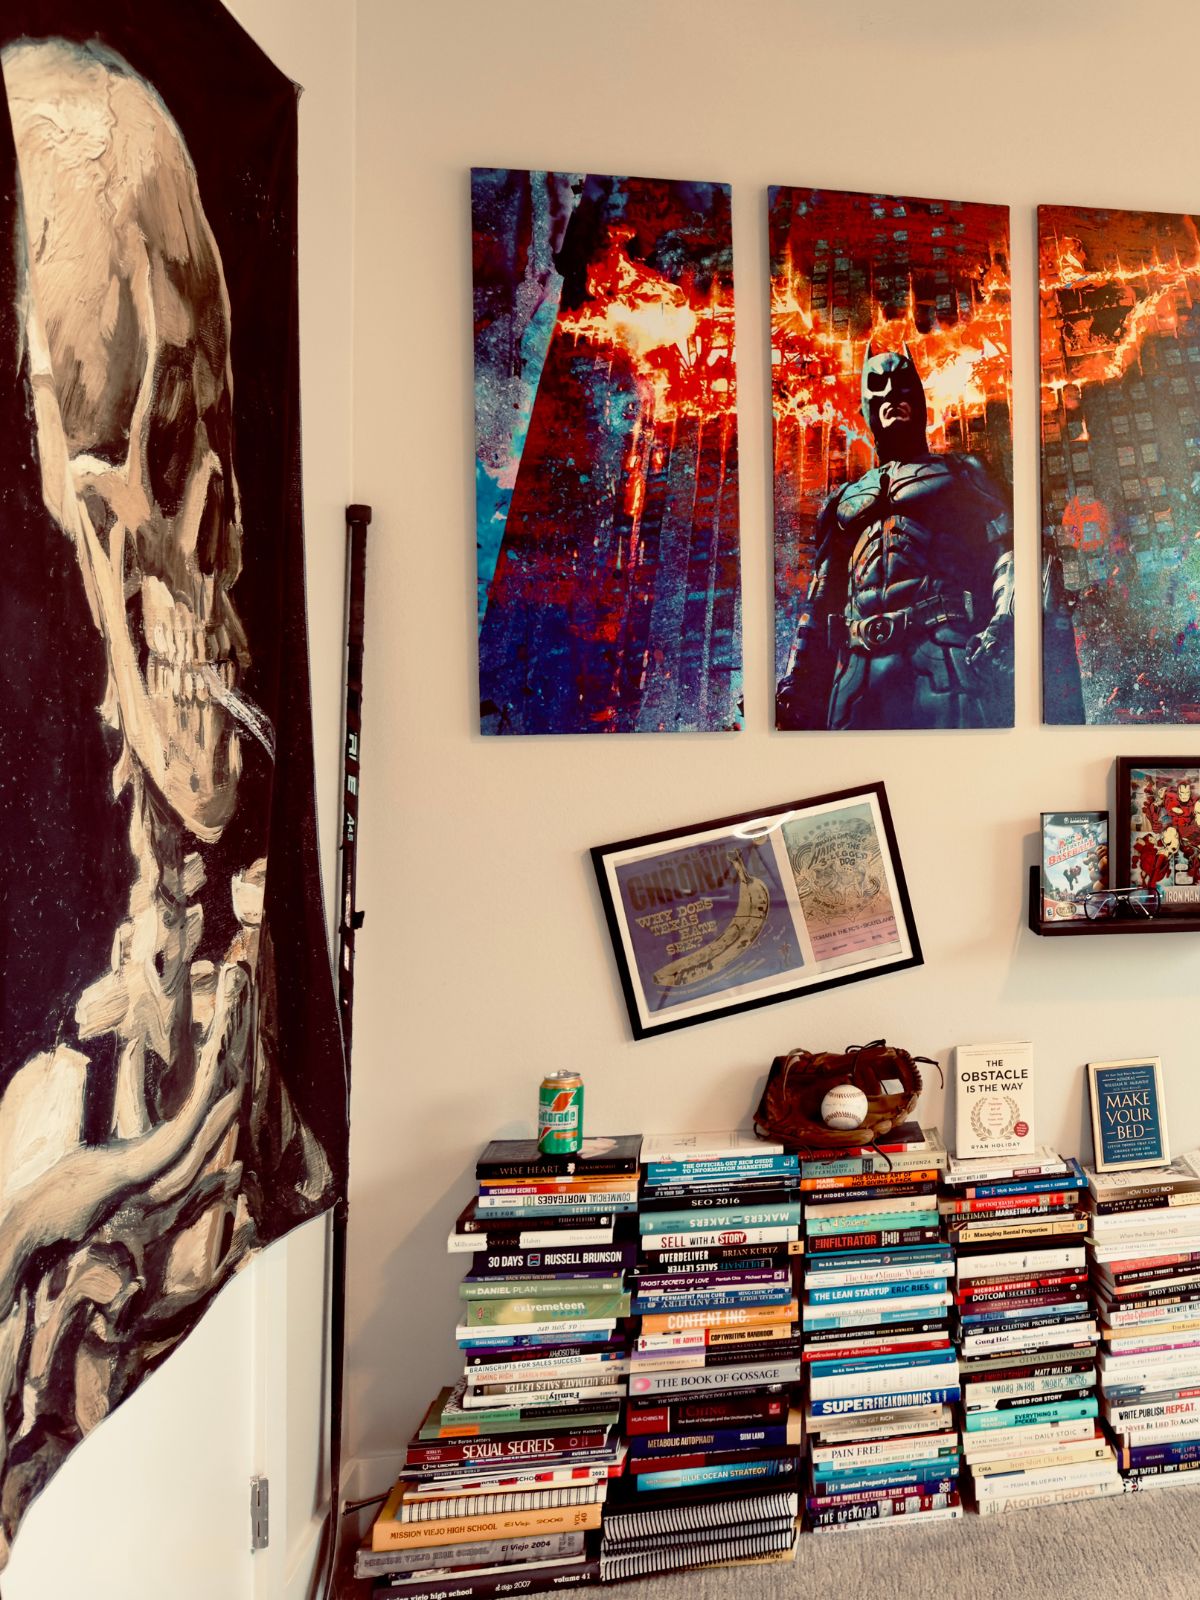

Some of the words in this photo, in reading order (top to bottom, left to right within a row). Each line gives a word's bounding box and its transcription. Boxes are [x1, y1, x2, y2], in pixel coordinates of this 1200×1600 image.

[1165, 891, 1183, 903] IRON
[1184, 890, 1200, 903] MAN
[635, 910, 673, 928] WHY
[677, 899, 713, 917] DOES
[650, 914, 699, 936] TEXAS
[986, 1059, 1004, 1067] THE
[961, 1068, 1029, 1082] OBSTACLE
[966, 1085, 976, 1093] IS
[978, 1084, 998, 1092] THE
[1001, 1082, 1024, 1091] WAY
[1106, 1091, 1151, 1109] MAKE
[1105, 1107, 1153, 1127] YOUR
[1117, 1123, 1145, 1140] BED
[537, 1194, 587, 1205] MORTGAGES
[588, 1192, 631, 1203] COMMERCIAL
[691, 1199, 713, 1207] SEO
[715, 1197, 740, 1205] 2016
[744, 1212, 790, 1223] MAKERS
[956, 1211, 995, 1221] ULTIMATE
[995, 1207, 1031, 1217] MARKETING
[689, 1217, 730, 1227] TAKERS
[973, 1230, 1002, 1238] Managing
[1021, 1226, 1048, 1234] Properties
[661, 1236, 686, 1249] SELL
[689, 1236, 709, 1246] WITH
[710, 1236, 716, 1245] A
[719, 1233, 745, 1243] STORY
[488, 1256, 500, 1268] 30
[501, 1255, 524, 1267] DAYS
[544, 1253, 581, 1266] RUSSELL
[582, 1251, 622, 1264] BRUNSON
[659, 1250, 709, 1264] OVERDELIVER
[722, 1249, 748, 1257] BRIAN
[750, 1246, 779, 1255] KURTZ
[477, 1287, 511, 1296] DANIEL
[512, 1286, 538, 1294] PLAN
[814, 1291, 831, 1301] THE
[832, 1289, 853, 1299] LEAN
[854, 1287, 890, 1297] STARTUP
[891, 1285, 909, 1294] ERIC
[911, 1283, 930, 1292] RIES
[972, 1291, 1006, 1302] DOTCOM
[1007, 1289, 1035, 1297] SECRETS
[1148, 1289, 1166, 1297] BODY
[1168, 1286, 1186, 1294] MIND
[667, 1310, 722, 1330] CONTENT
[725, 1309, 751, 1324] INC.
[996, 1335, 1009, 1343] Ho!
[469, 1363, 517, 1374] BRAINSCRIPTS
[517, 1361, 531, 1370] FOR
[532, 1359, 552, 1368] SALES
[553, 1356, 582, 1365] SUCCESS
[1034, 1369, 1052, 1377] MATT
[1051, 1366, 1073, 1375] WALSH
[654, 1376, 680, 1389] THE
[681, 1372, 712, 1386] BOOK
[714, 1371, 730, 1383] OF
[731, 1369, 780, 1382] GOSSAGE
[822, 1391, 932, 1414] SUPERFREAKONOMICS
[1010, 1398, 1030, 1406] WIRED
[1031, 1396, 1043, 1404] FOR
[1043, 1394, 1063, 1402] STORY
[1014, 1410, 1052, 1420] EVERYTHING
[1125, 1423, 1145, 1432] NEVER
[1146, 1422, 1154, 1430] BE
[1155, 1421, 1170, 1429] LIED
[1179, 1417, 1199, 1425] AGAIN
[462, 1442, 505, 1460] SEXUAL
[507, 1438, 555, 1455] SECRETS
[831, 1449, 855, 1459] PAIN
[856, 1445, 882, 1456] FREE
[681, 1474, 701, 1482] BLUE
[702, 1471, 729, 1480] OCEAN
[729, 1466, 768, 1477] STRATEGY
[840, 1482, 861, 1490] Rental
[861, 1478, 888, 1489] Property
[888, 1474, 917, 1484] Investing
[1002, 1494, 1051, 1513] Atomic
[390, 1529, 422, 1540] MISSION
[423, 1527, 446, 1537] VIEJO
[446, 1525, 466, 1534] HIGH
[466, 1523, 498, 1532] SCHOOL
[448, 1588, 473, 1597] school
[553, 1574, 578, 1584] volume
[578, 1572, 591, 1581] 41
